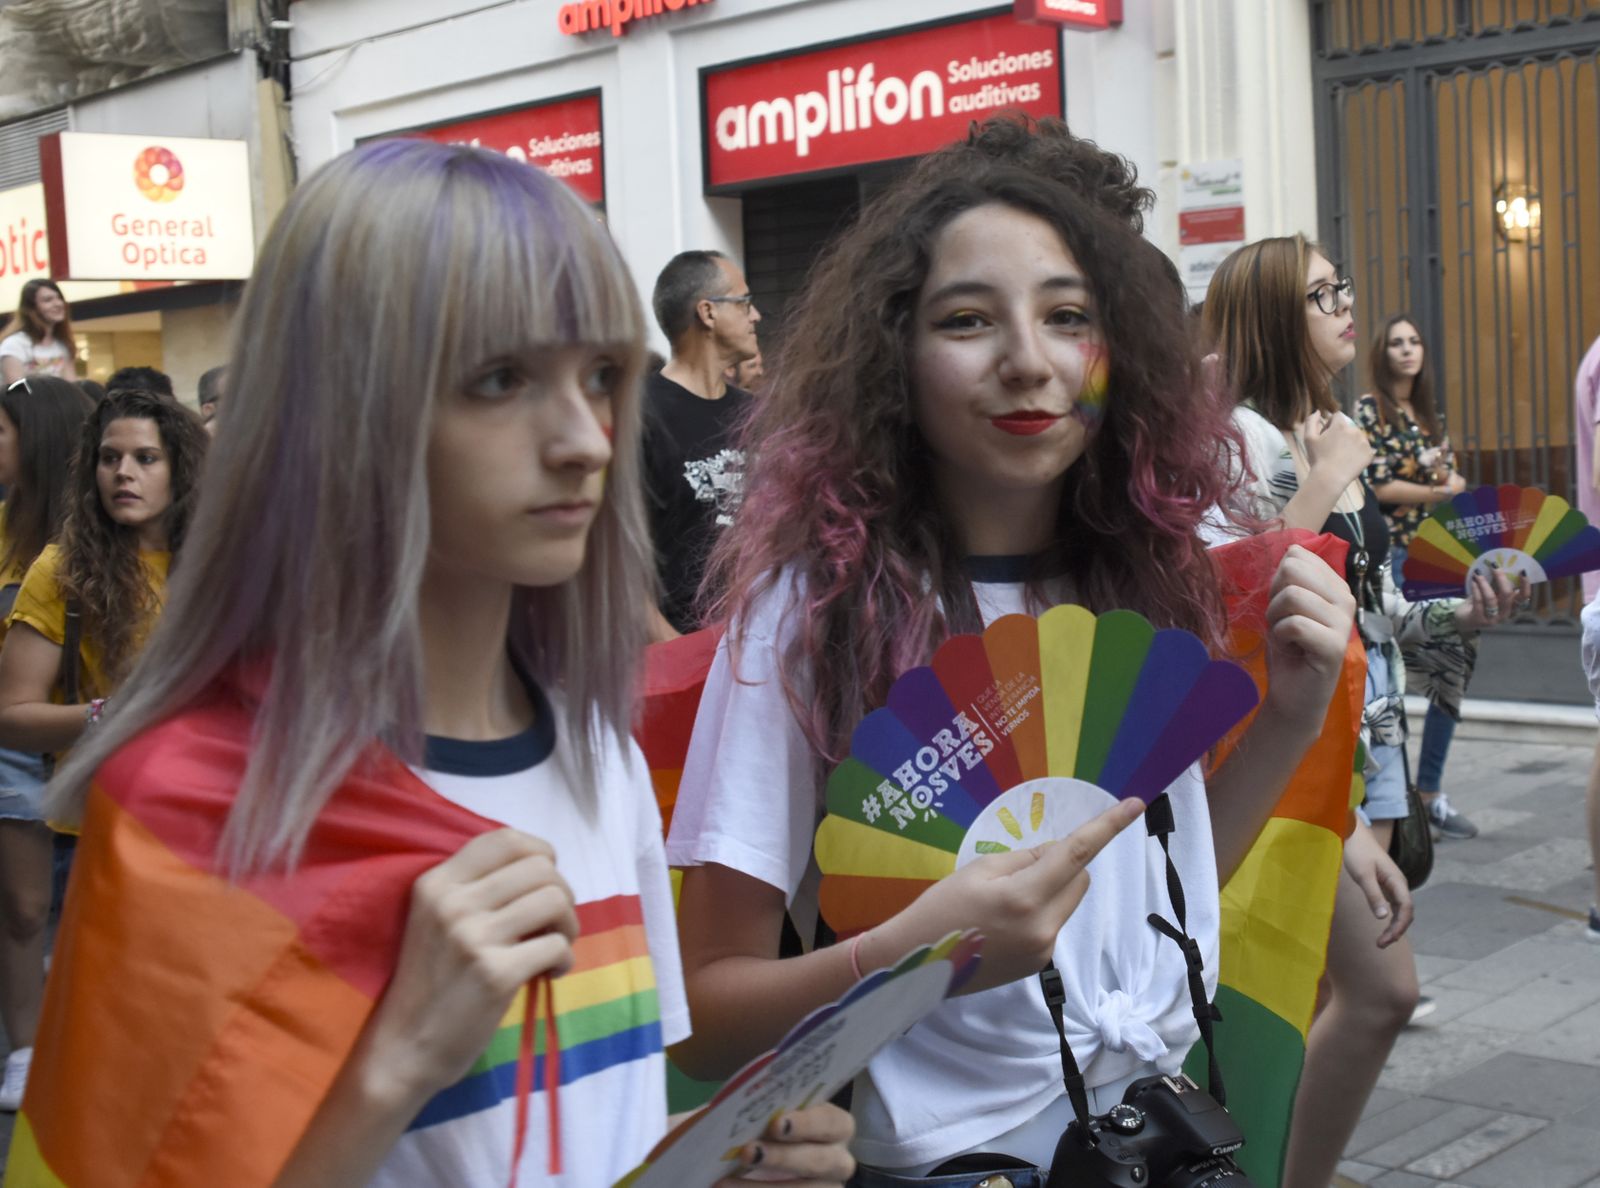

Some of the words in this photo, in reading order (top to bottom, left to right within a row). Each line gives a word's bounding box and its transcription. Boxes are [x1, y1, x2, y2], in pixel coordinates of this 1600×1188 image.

[947, 49, 1053, 84] Soluciones
[715, 62, 944, 157] amplifon
[949, 81, 1041, 113] auditivas
[529, 131, 601, 157] Soluciones
[543, 156, 593, 177] ditivas
[111, 213, 214, 237] General
[122, 241, 207, 270] Optica
[862, 711, 979, 823] #AHORA
[889, 730, 994, 830] NOSVES
